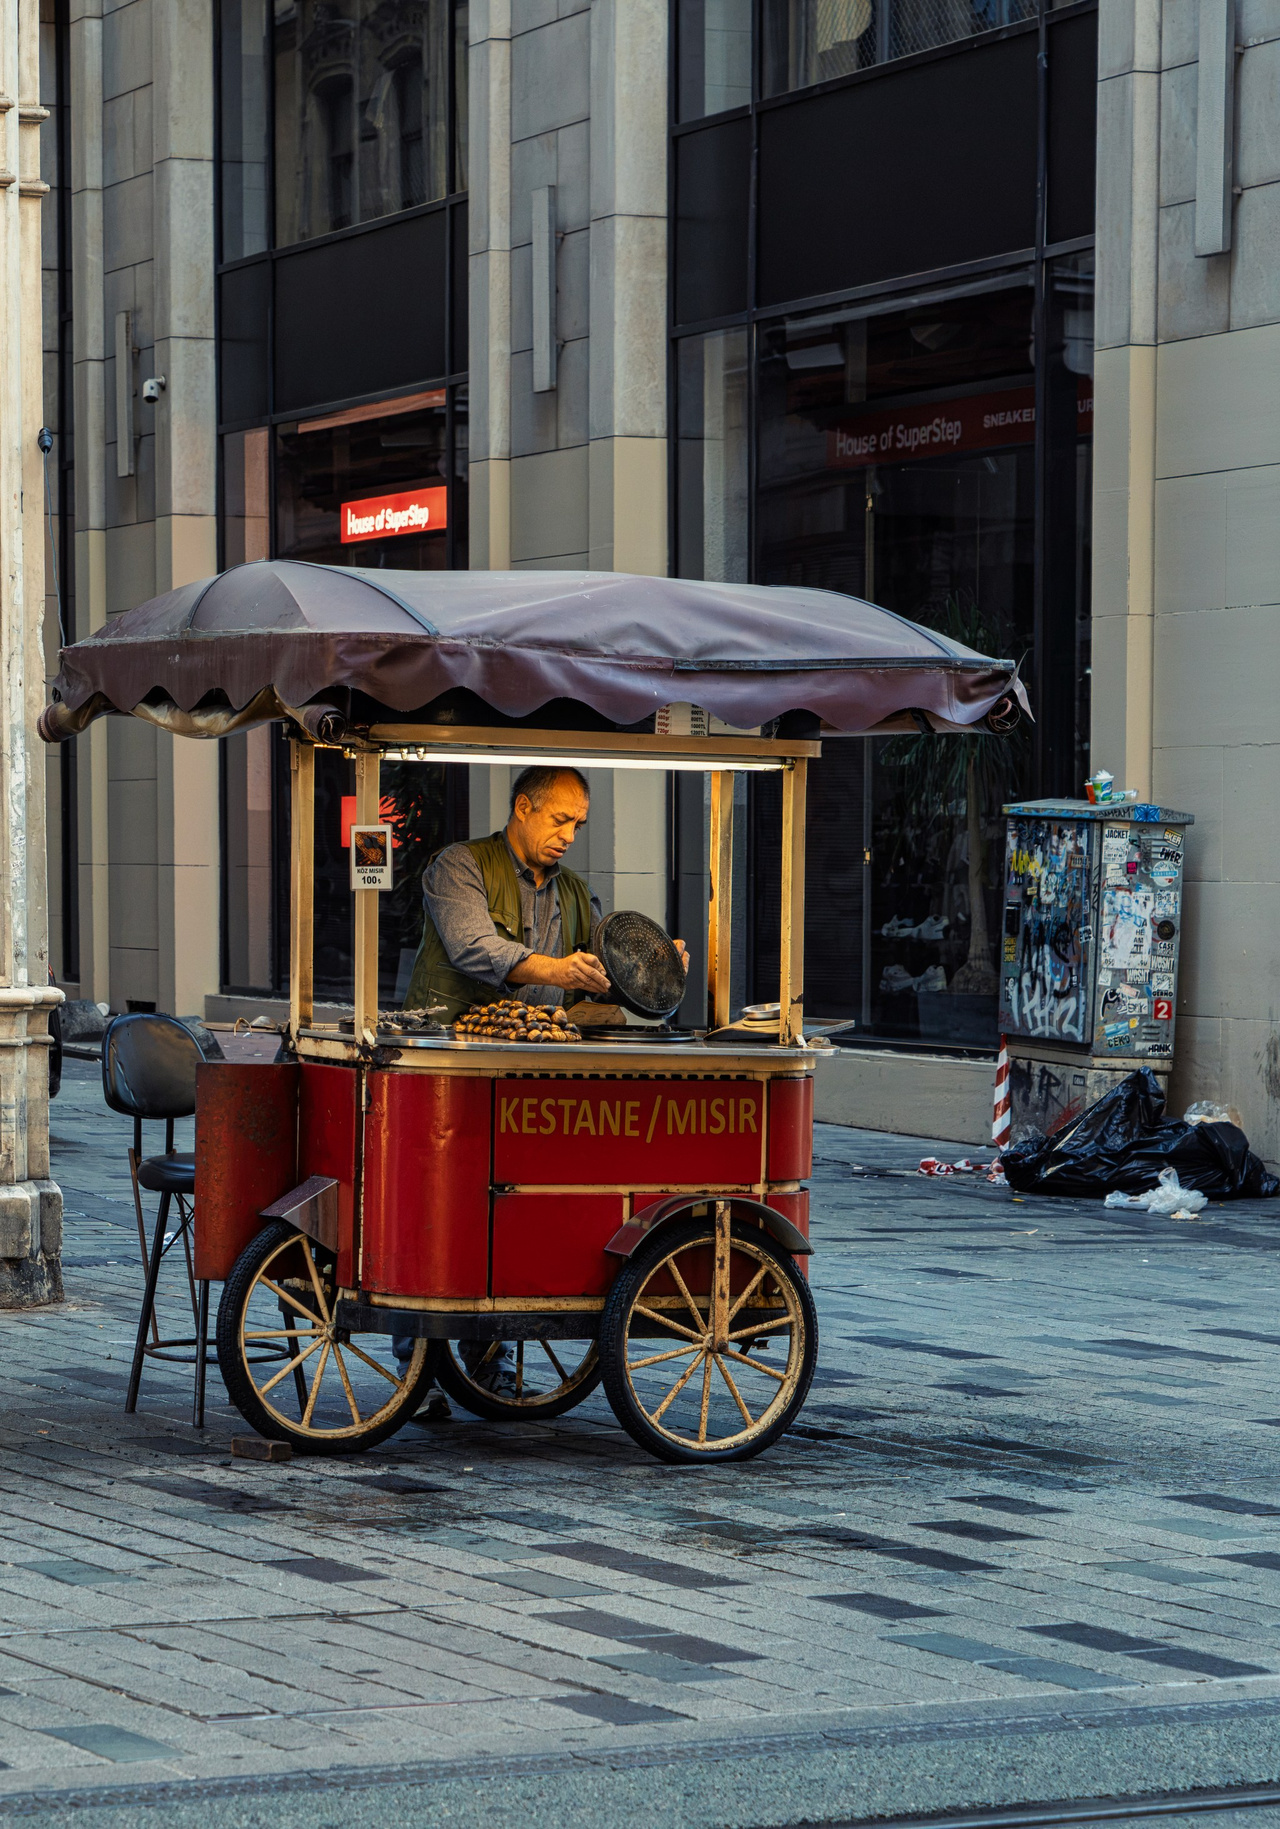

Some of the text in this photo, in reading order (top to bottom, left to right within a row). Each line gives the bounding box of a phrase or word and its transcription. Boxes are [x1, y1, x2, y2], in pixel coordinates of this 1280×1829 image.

[836, 427, 876, 457] House
[880, 426, 894, 449] of
[896, 417, 963, 453] SuperStep
[347, 504, 429, 535] House of SuperStep
[1105, 829, 1129, 839] JACKET
[1157, 1001, 1168, 1019] 2
